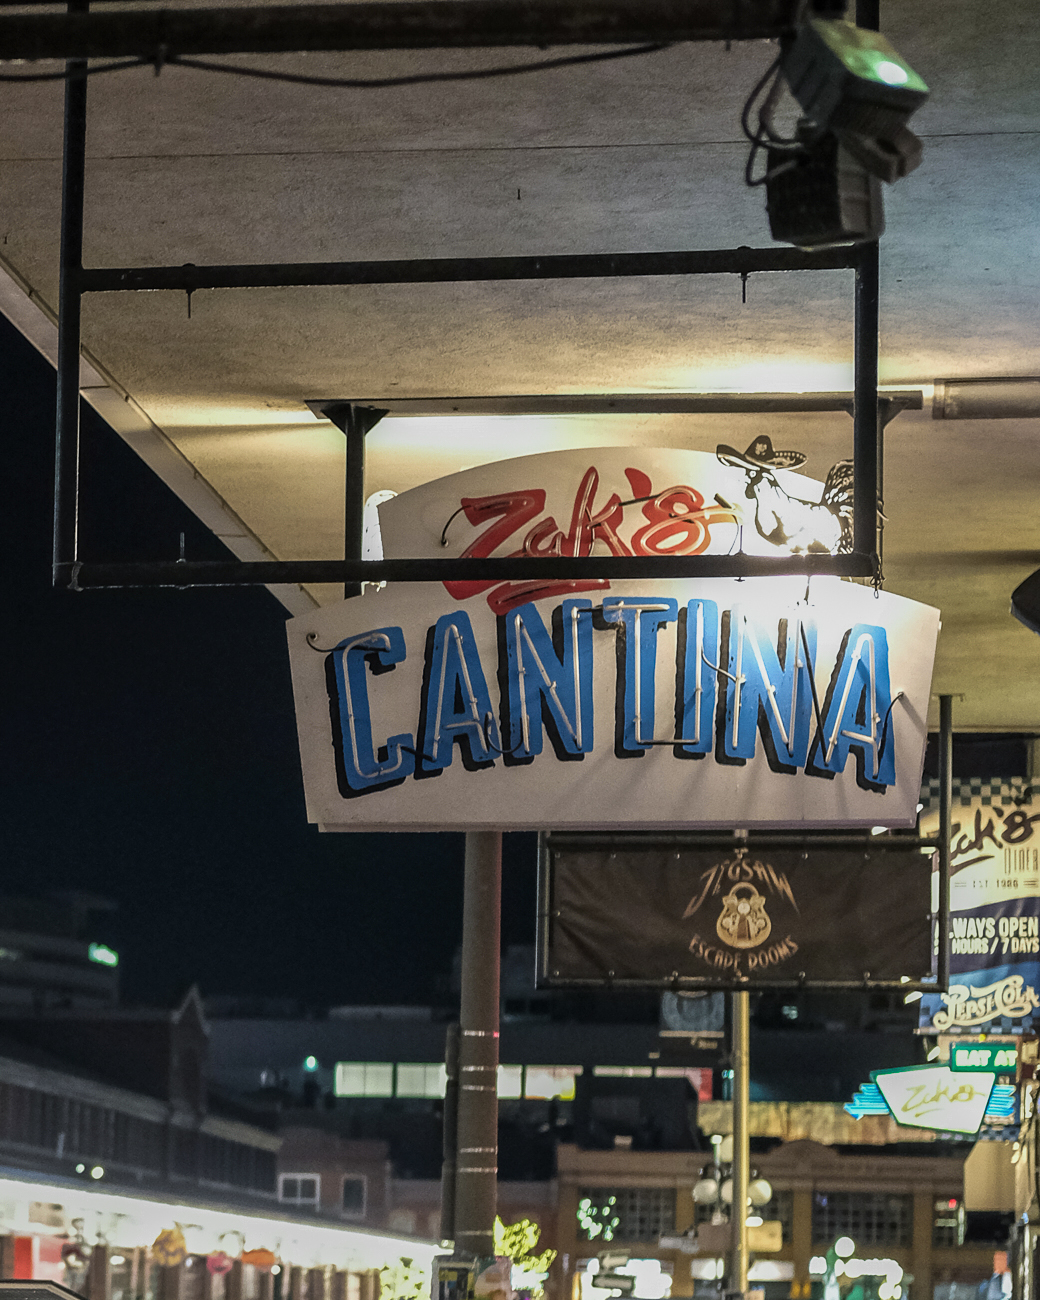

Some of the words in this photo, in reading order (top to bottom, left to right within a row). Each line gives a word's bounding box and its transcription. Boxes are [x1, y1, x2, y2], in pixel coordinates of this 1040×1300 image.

[442, 466, 743, 614] Zak's
[325, 597, 897, 798] CANTINA
[934, 917, 996, 939] WAYS
[999, 917, 1039, 938] OPEN
[688, 933, 741, 972] ESCAPE
[747, 934, 799, 971] ROOMS
[951, 938, 989, 954] HOURS
[1001, 938, 1010, 954] 7
[1011, 938, 1040, 954] DAYS
[956, 1050, 991, 1067] EAT
[994, 1050, 1018, 1067] AT
